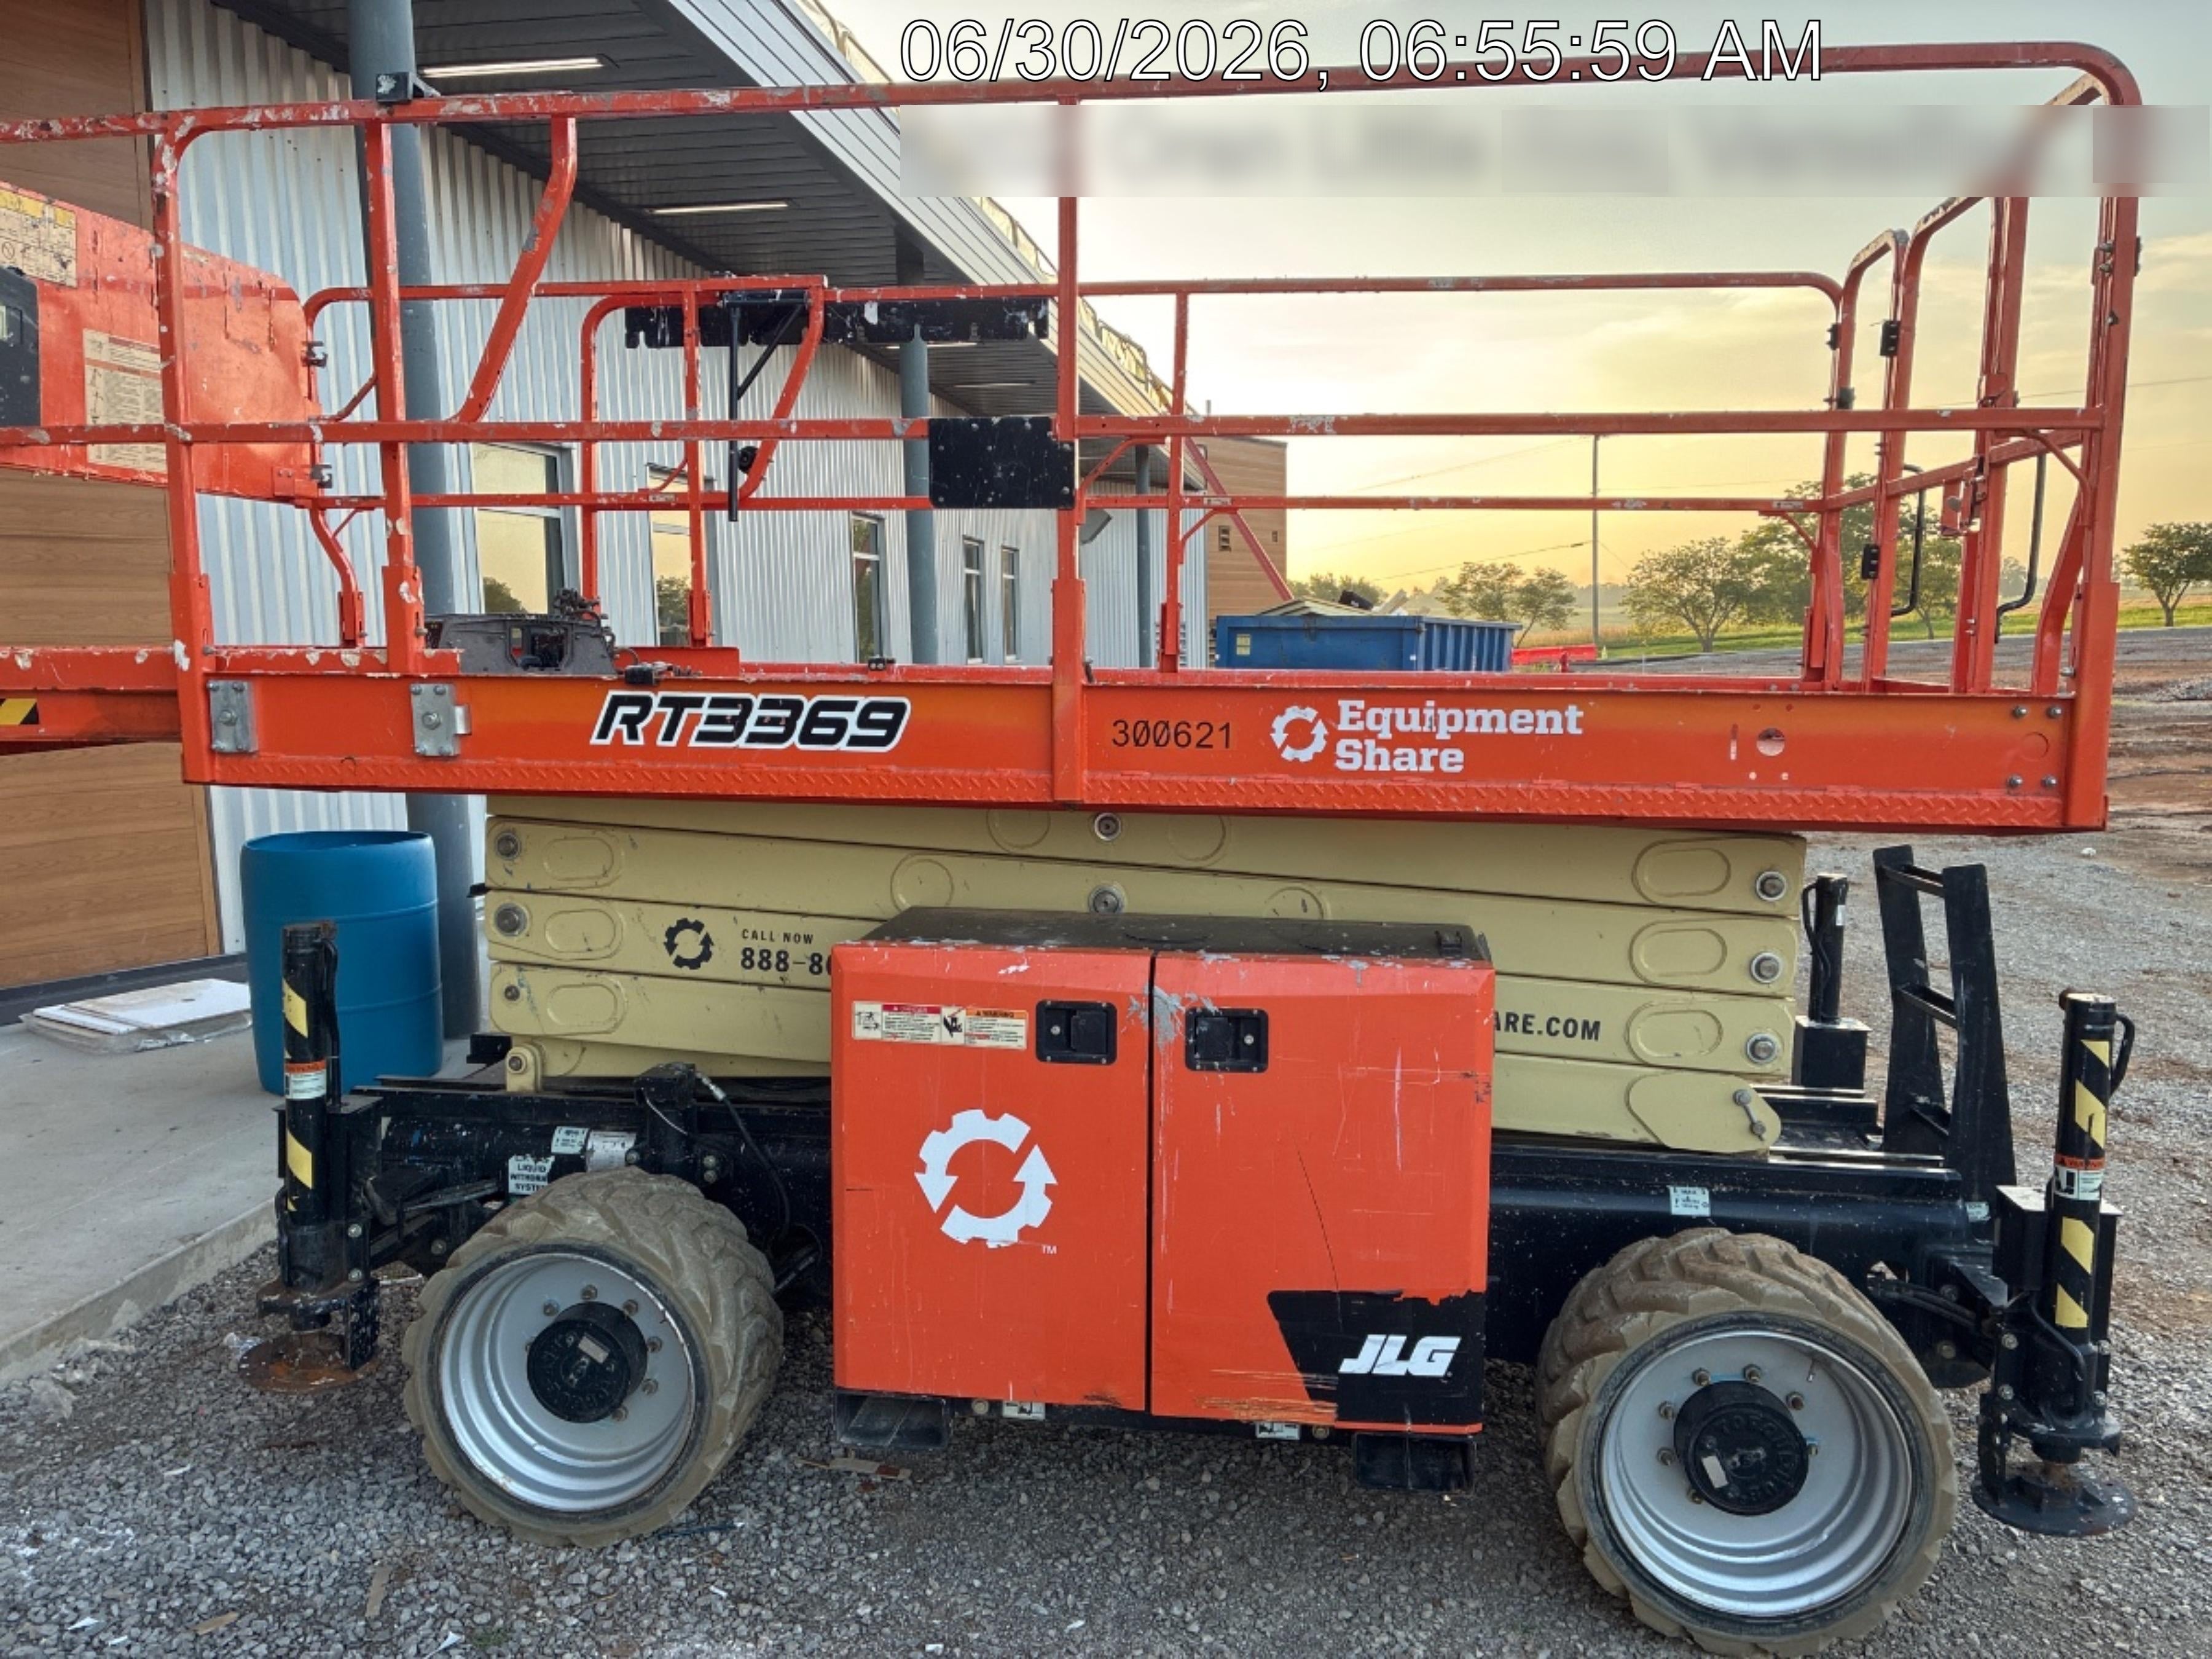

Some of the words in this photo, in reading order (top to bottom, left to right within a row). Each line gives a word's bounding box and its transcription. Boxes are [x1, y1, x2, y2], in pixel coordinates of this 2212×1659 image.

[590, 691, 911, 752] RT3369
[1112, 720, 1230, 749] 300621
[1338, 699, 1583, 740] Equipment
[1335, 739, 1465, 773] Share
[742, 928, 775, 943] CALL
[783, 931, 814, 944] NOW
[1042, 1244, 1057, 1254] TM
[1338, 1334, 1462, 1376] JLG
